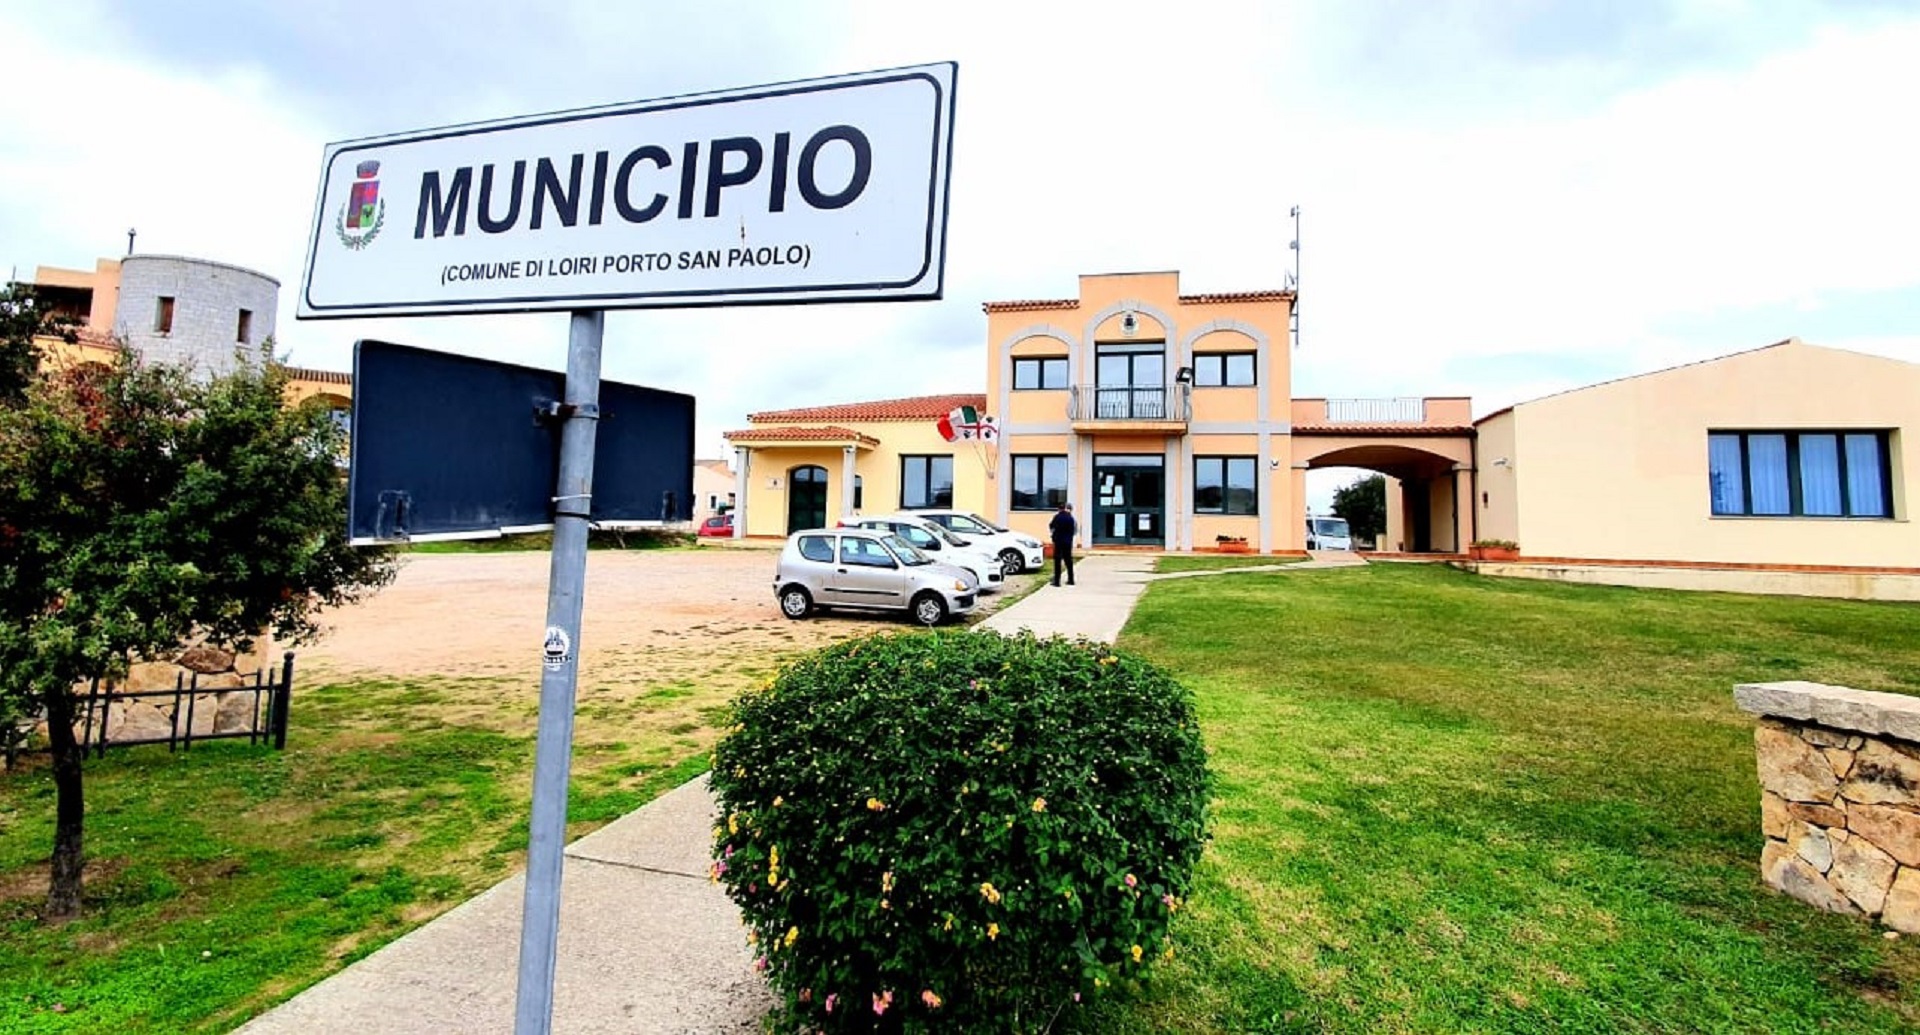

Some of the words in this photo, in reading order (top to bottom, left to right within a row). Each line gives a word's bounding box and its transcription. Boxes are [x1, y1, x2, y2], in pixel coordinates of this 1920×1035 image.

[413, 124, 872, 240] MUNICIPIO
[441, 260, 521, 286] (COMUNE
[525, 259, 543, 277] DI
[548, 256, 597, 276] LOIRI
[602, 252, 672, 274] PORTO
[677, 249, 721, 270] SAN
[727, 244, 811, 269] PAOLO)
